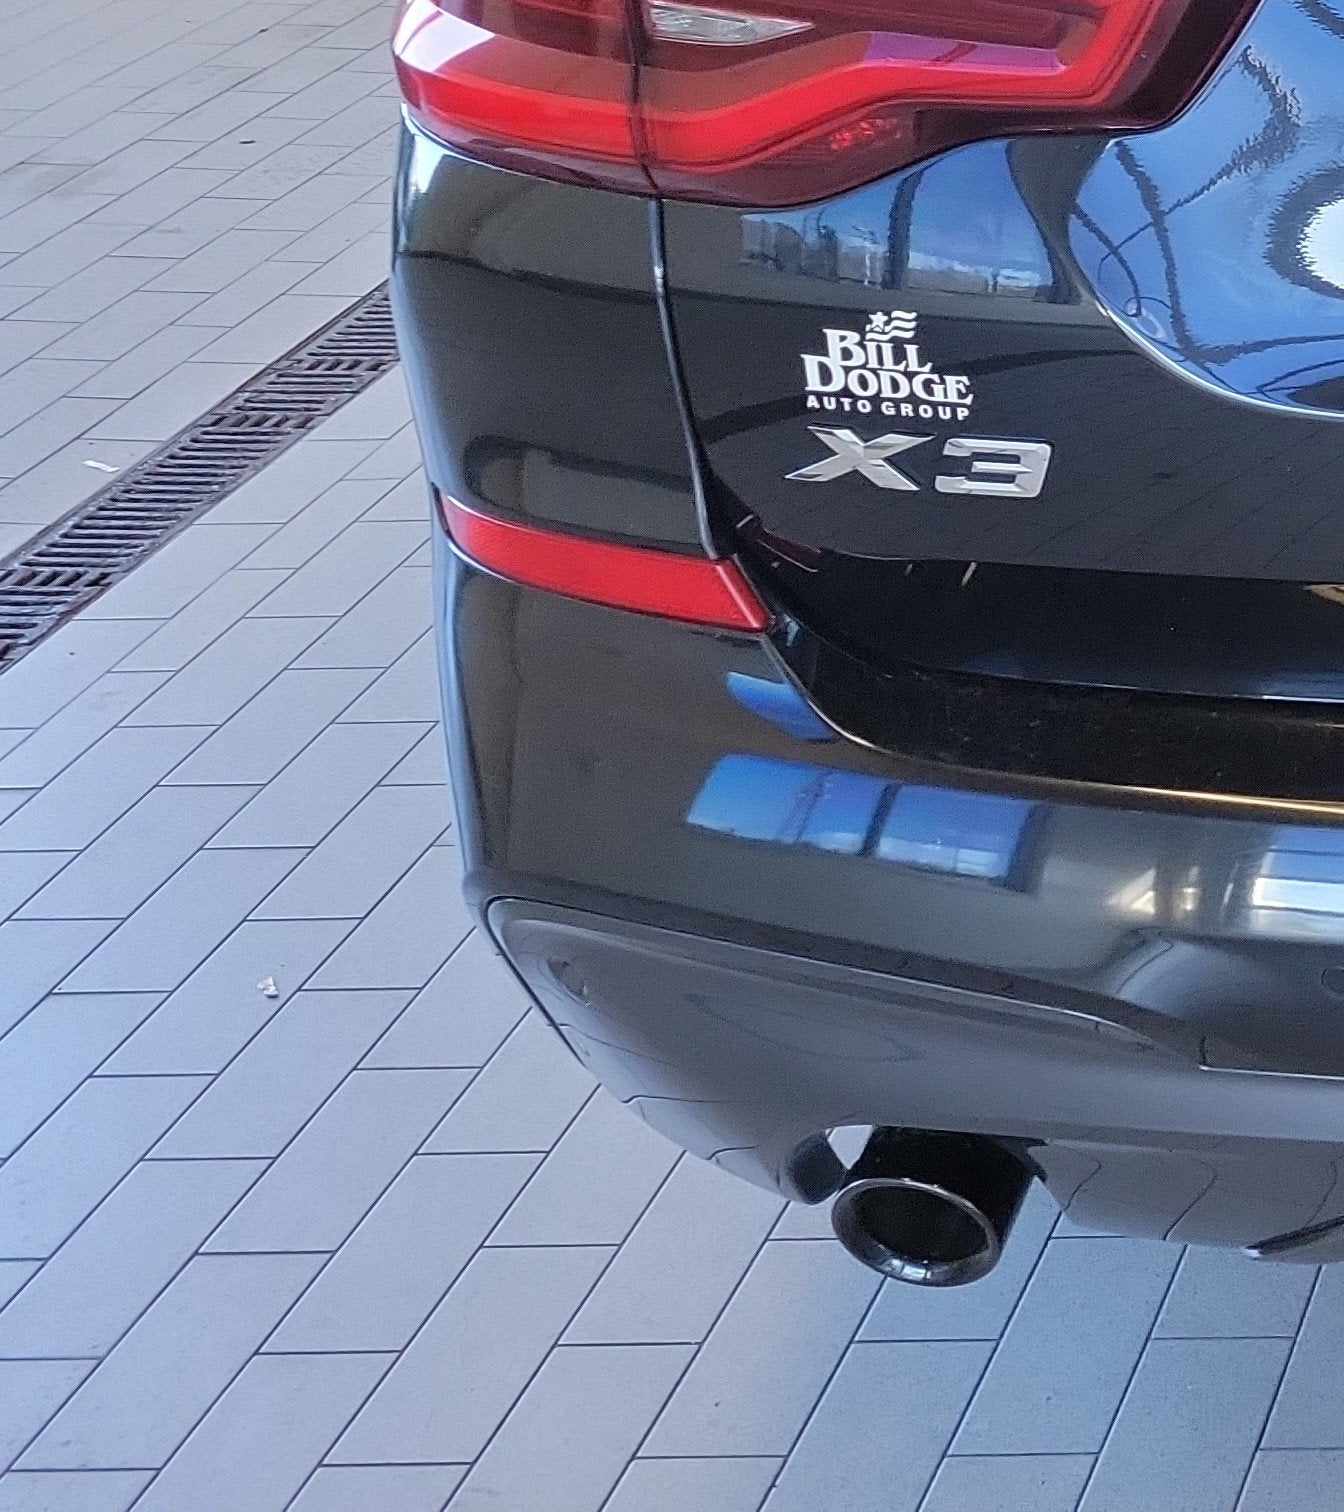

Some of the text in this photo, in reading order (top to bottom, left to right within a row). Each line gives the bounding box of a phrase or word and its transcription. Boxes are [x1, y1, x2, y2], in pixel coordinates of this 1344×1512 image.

[822, 327, 934, 374] BILL
[799, 353, 975, 406] DODGE
[805, 393, 971, 421] AUTO GROUP
[784, 424, 1053, 499] X3
